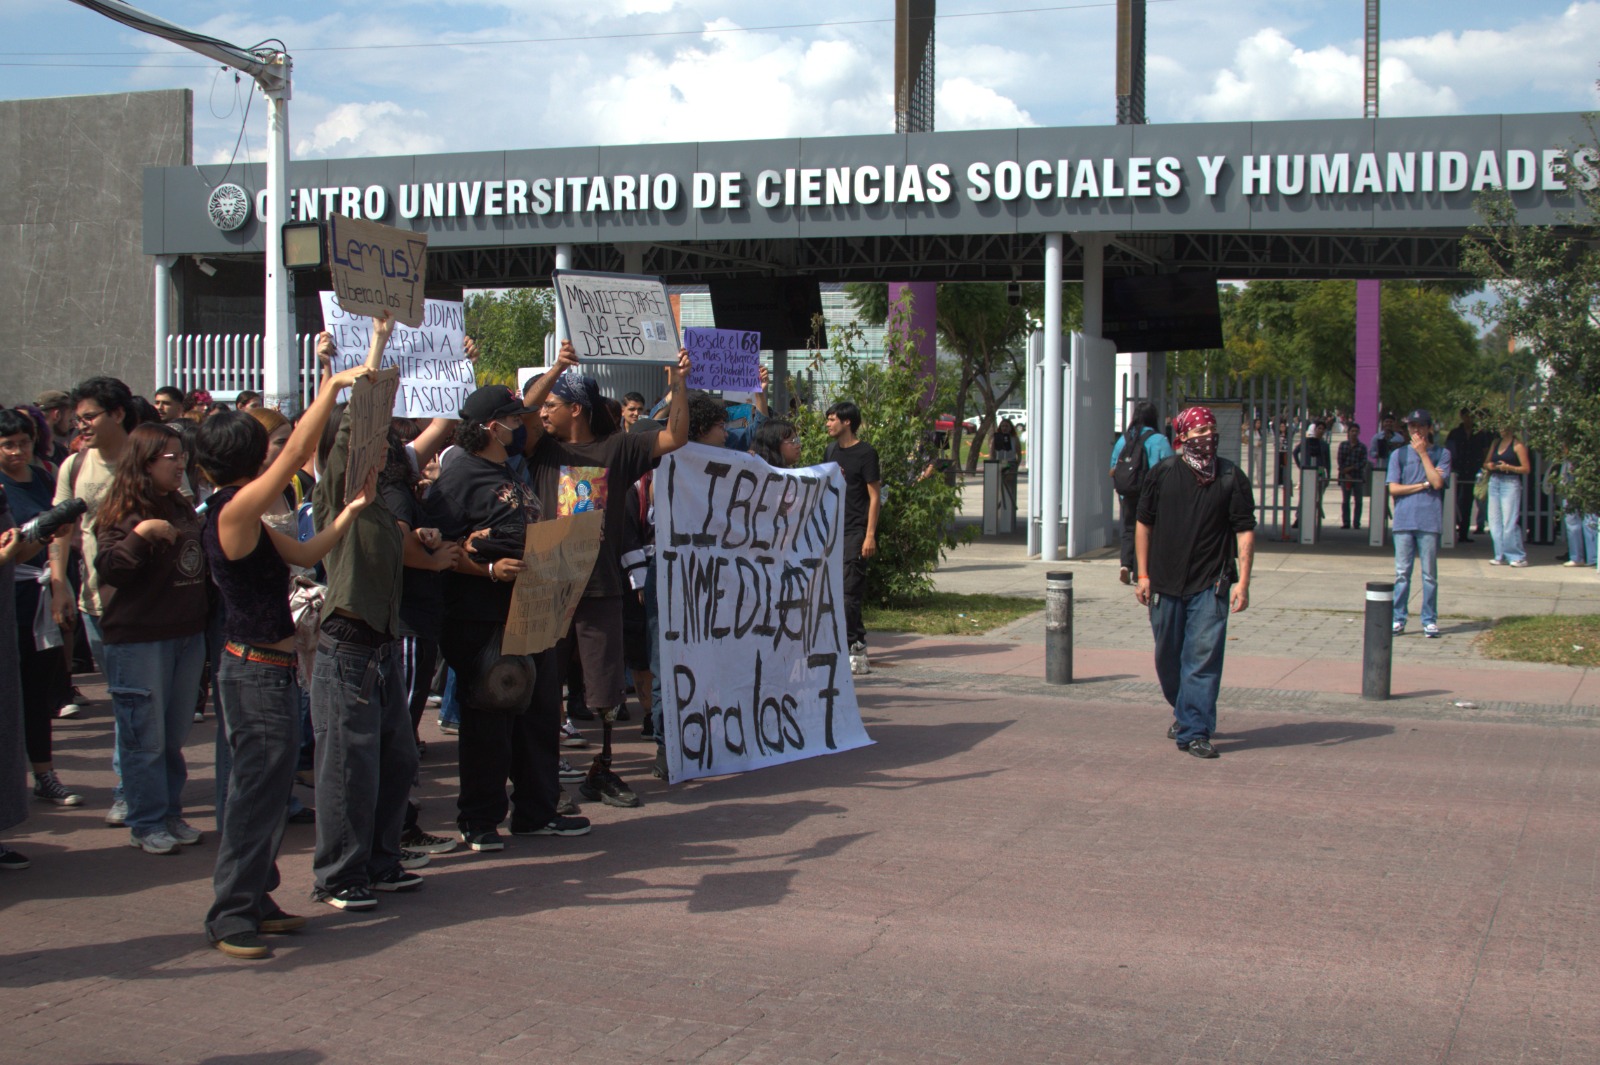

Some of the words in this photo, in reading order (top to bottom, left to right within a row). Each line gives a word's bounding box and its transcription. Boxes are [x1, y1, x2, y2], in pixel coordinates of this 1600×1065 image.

[399, 172, 677, 219] UNIVERSITARIO
[693, 170, 742, 210] DE
[756, 163, 952, 208] CIENCIAS
[966, 155, 1181, 201] SOCIALES
[1197, 155, 1226, 195] Y
[1242, 148, 1600, 195] HUMANIDADES
[402, 277, 415, 318] 7
[565, 284, 668, 316] MANIFESTARSE
[423, 303, 464, 332] UDIAN
[587, 314, 609, 334] NO
[615, 316, 641, 335] ES
[366, 328, 435, 354] LBEREN
[440, 334, 454, 356] A
[579, 330, 645, 356] DELITO
[688, 330, 725, 350] Desde
[728, 332, 739, 350] el
[741, 331, 759, 354] 68
[380, 353, 474, 384] ANIFESTANTES
[667, 454, 840, 557] LIBERTAD
[673, 664, 748, 772] Para
[752, 649, 806, 757] los
[807, 652, 840, 750] 7
